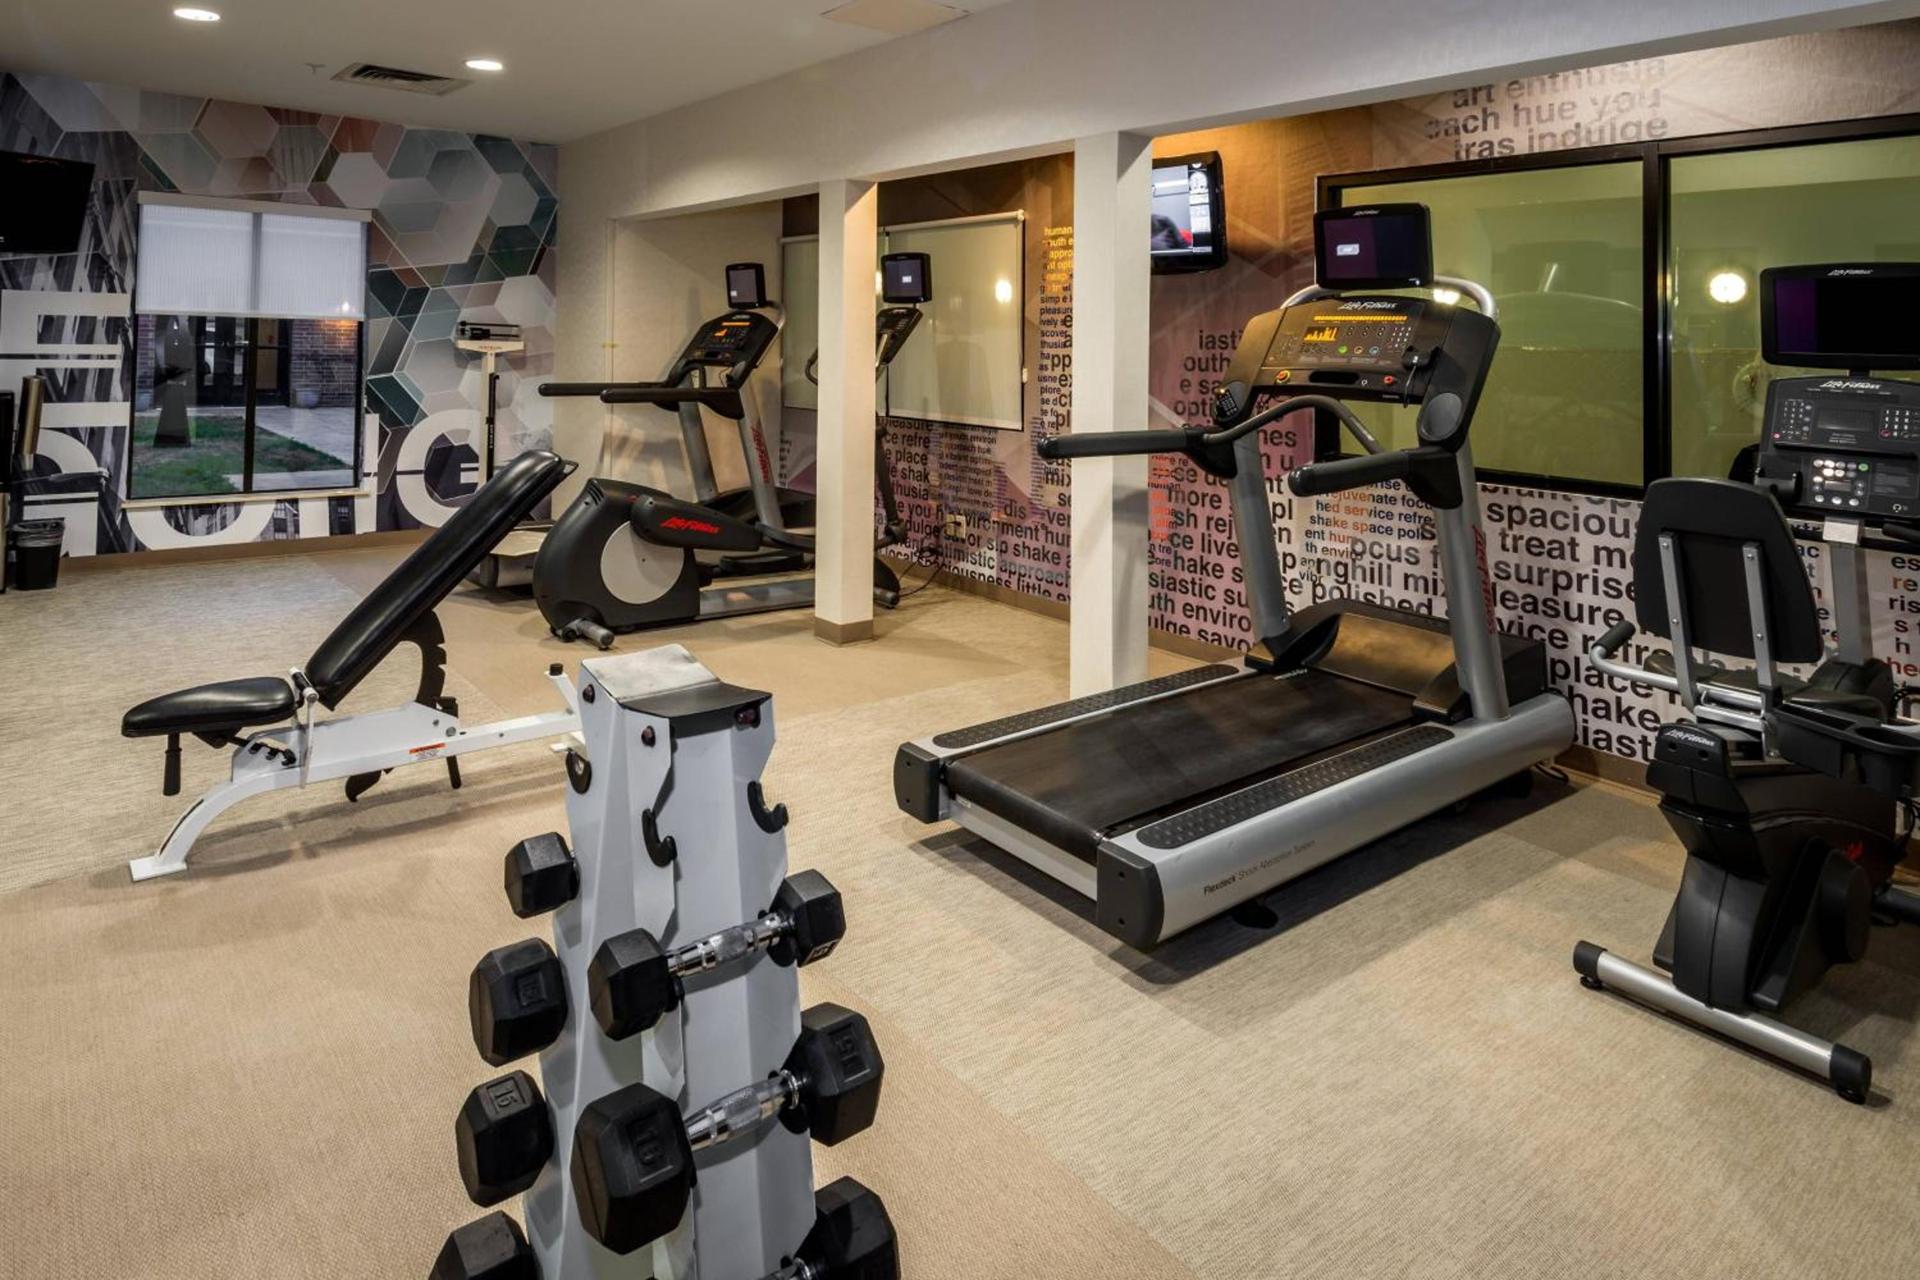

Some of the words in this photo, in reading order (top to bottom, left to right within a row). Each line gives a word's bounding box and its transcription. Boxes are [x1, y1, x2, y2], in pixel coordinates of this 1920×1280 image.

[1513, 101, 1576, 127] hue
[1590, 87, 1661, 119] you
[1167, 486, 1223, 510] more
[1344, 505, 1394, 521] service
[1173, 508, 1198, 529] sh
[1310, 514, 1349, 530] shake
[1352, 520, 1393, 535] space
[1486, 501, 1641, 540] spaciou
[1305, 528, 1325, 541] ent
[1499, 528, 1580, 563] treat
[1593, 545, 1635, 570] m
[1013, 541, 1061, 566] shake
[1173, 550, 1225, 580] hake
[1148, 569, 1217, 601] siastic
[1493, 559, 1636, 601] surprise
[1182, 601, 1252, 632] enviro
[1575, 718, 1652, 763] iast
[500, 1085, 519, 1107] 15
